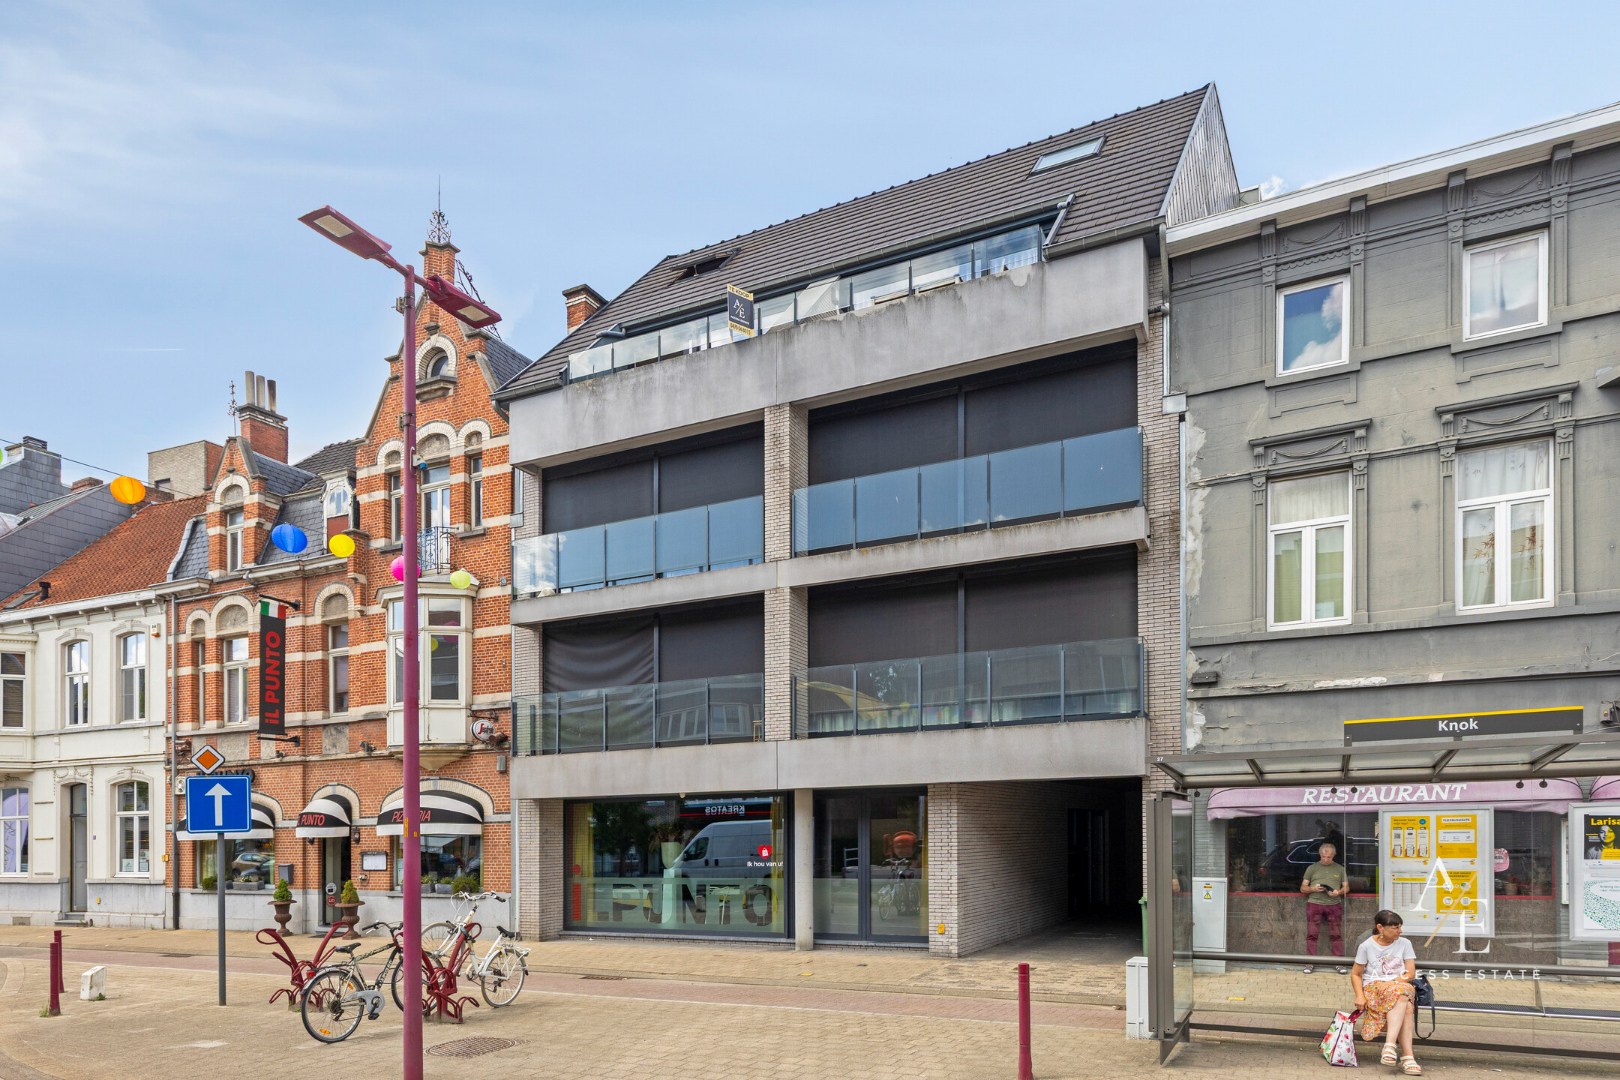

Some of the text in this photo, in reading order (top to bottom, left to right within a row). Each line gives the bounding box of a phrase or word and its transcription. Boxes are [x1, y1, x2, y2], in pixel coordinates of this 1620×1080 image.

[264, 631, 281, 704] PUNTO
[1438, 718, 1479, 731] Knok
[1301, 784, 1467, 804] RESTAURANT
[301, 814, 325, 826] PUNTO
[613, 884, 777, 927] PUNTO
